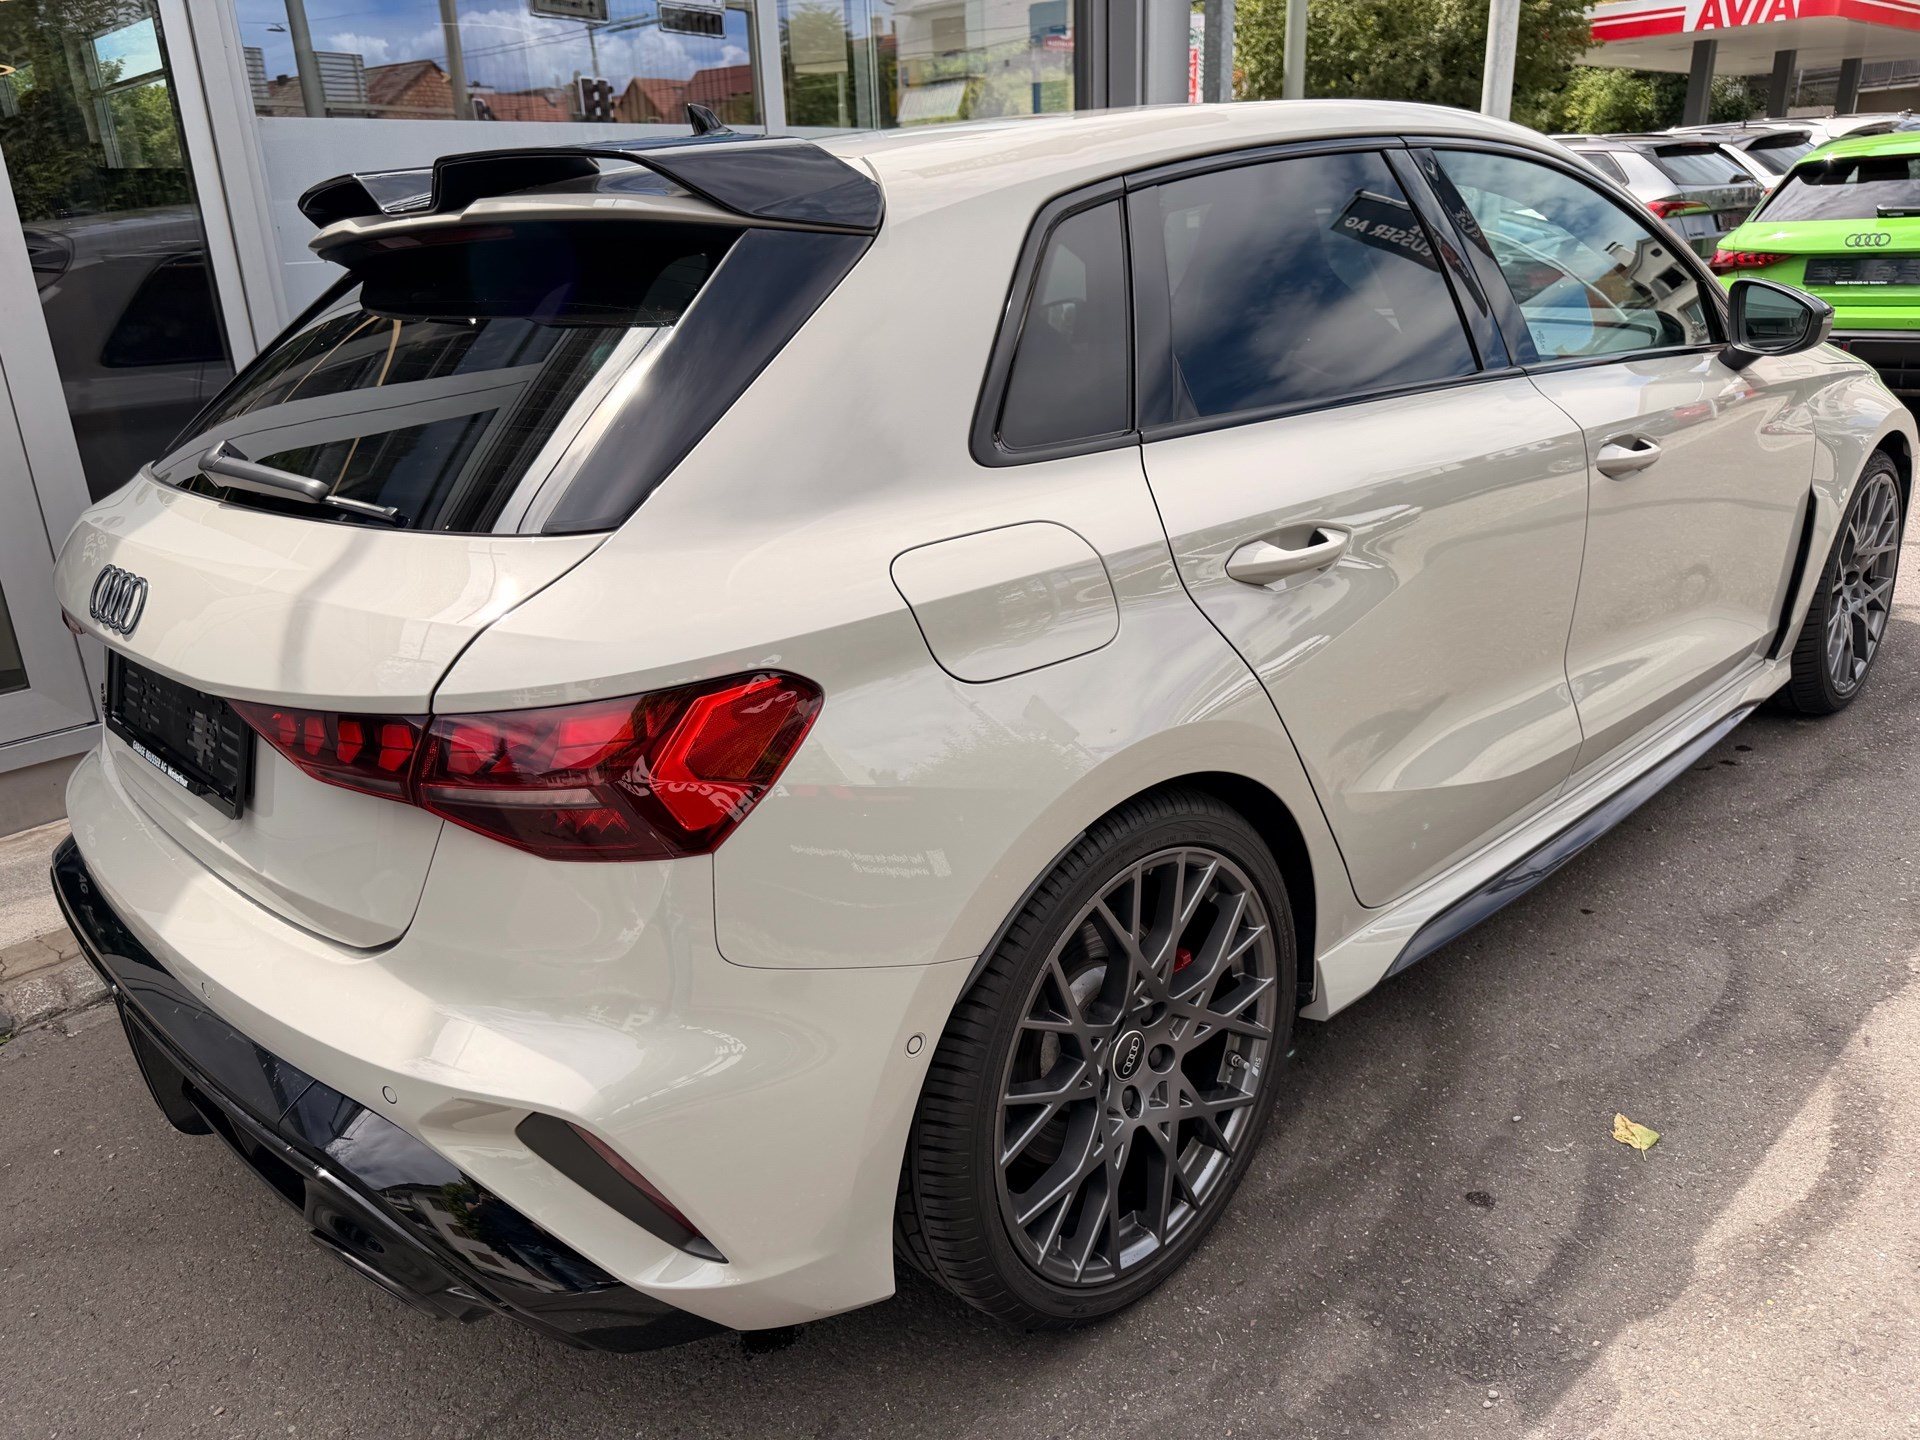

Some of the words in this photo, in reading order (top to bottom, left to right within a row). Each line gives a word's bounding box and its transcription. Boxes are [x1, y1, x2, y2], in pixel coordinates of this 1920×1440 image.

[1693, 0, 1797, 31] AVIA
[160, 760, 168, 773] AG
[1254, 1057, 1262, 1068] RS
